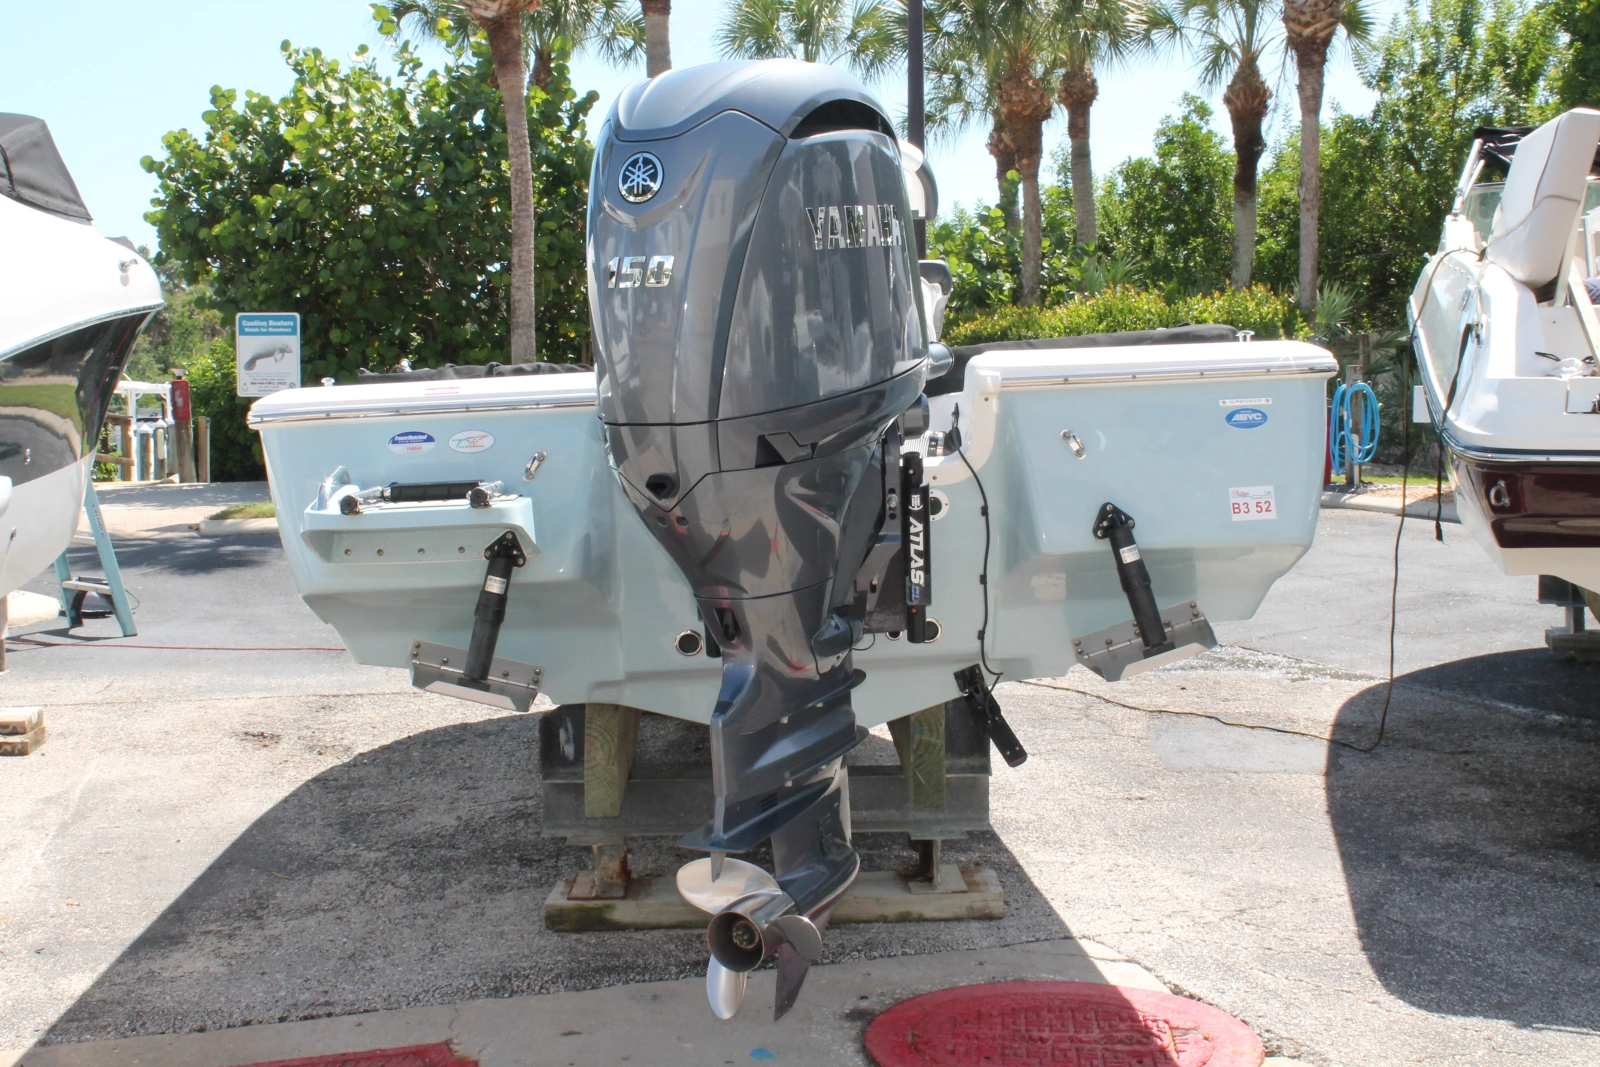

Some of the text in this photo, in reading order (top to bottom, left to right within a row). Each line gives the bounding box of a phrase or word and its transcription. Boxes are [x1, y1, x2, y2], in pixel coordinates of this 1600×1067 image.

[806, 204, 902, 250] YAMAHA
[608, 255, 675, 288] 150
[1231, 413, 1262, 421] ABYC
[1232, 500, 1272, 515] B3 52
[909, 516, 925, 585] ATLAS
